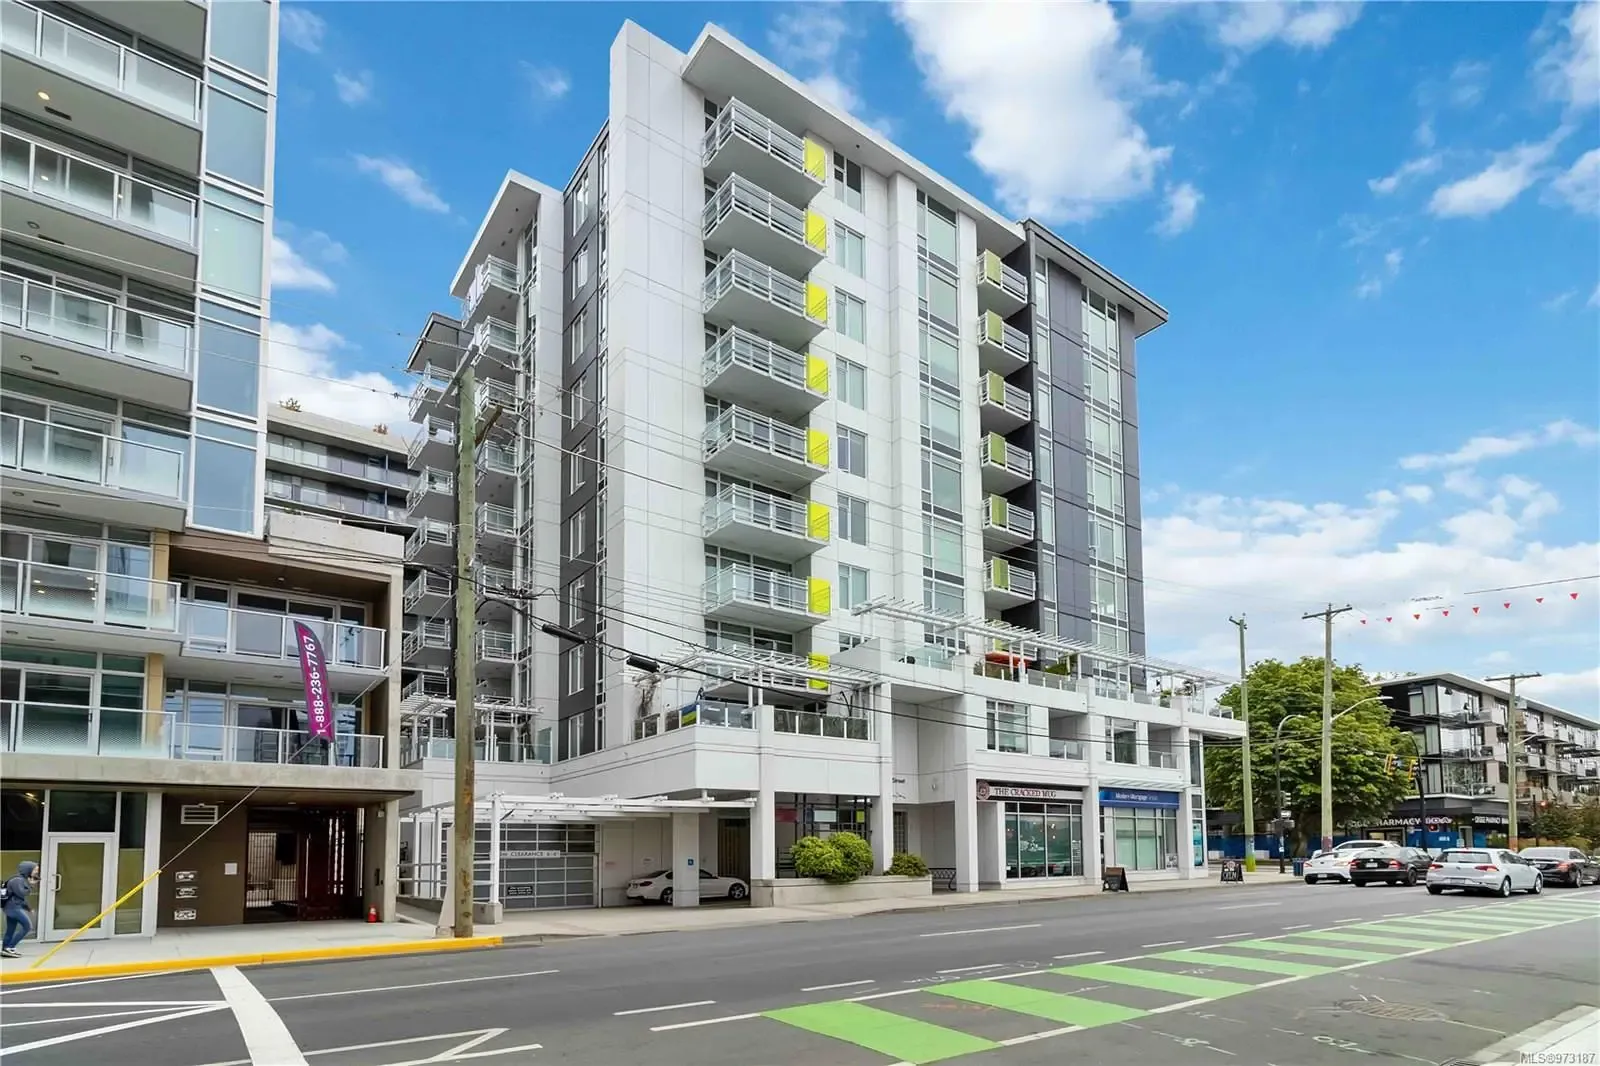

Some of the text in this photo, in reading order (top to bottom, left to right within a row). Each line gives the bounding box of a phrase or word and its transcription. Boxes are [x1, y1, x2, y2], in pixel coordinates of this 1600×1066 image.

[302, 635, 327, 735] 1-888-236-7767
[994, 787, 1057, 799] THE CRACKED MUG
